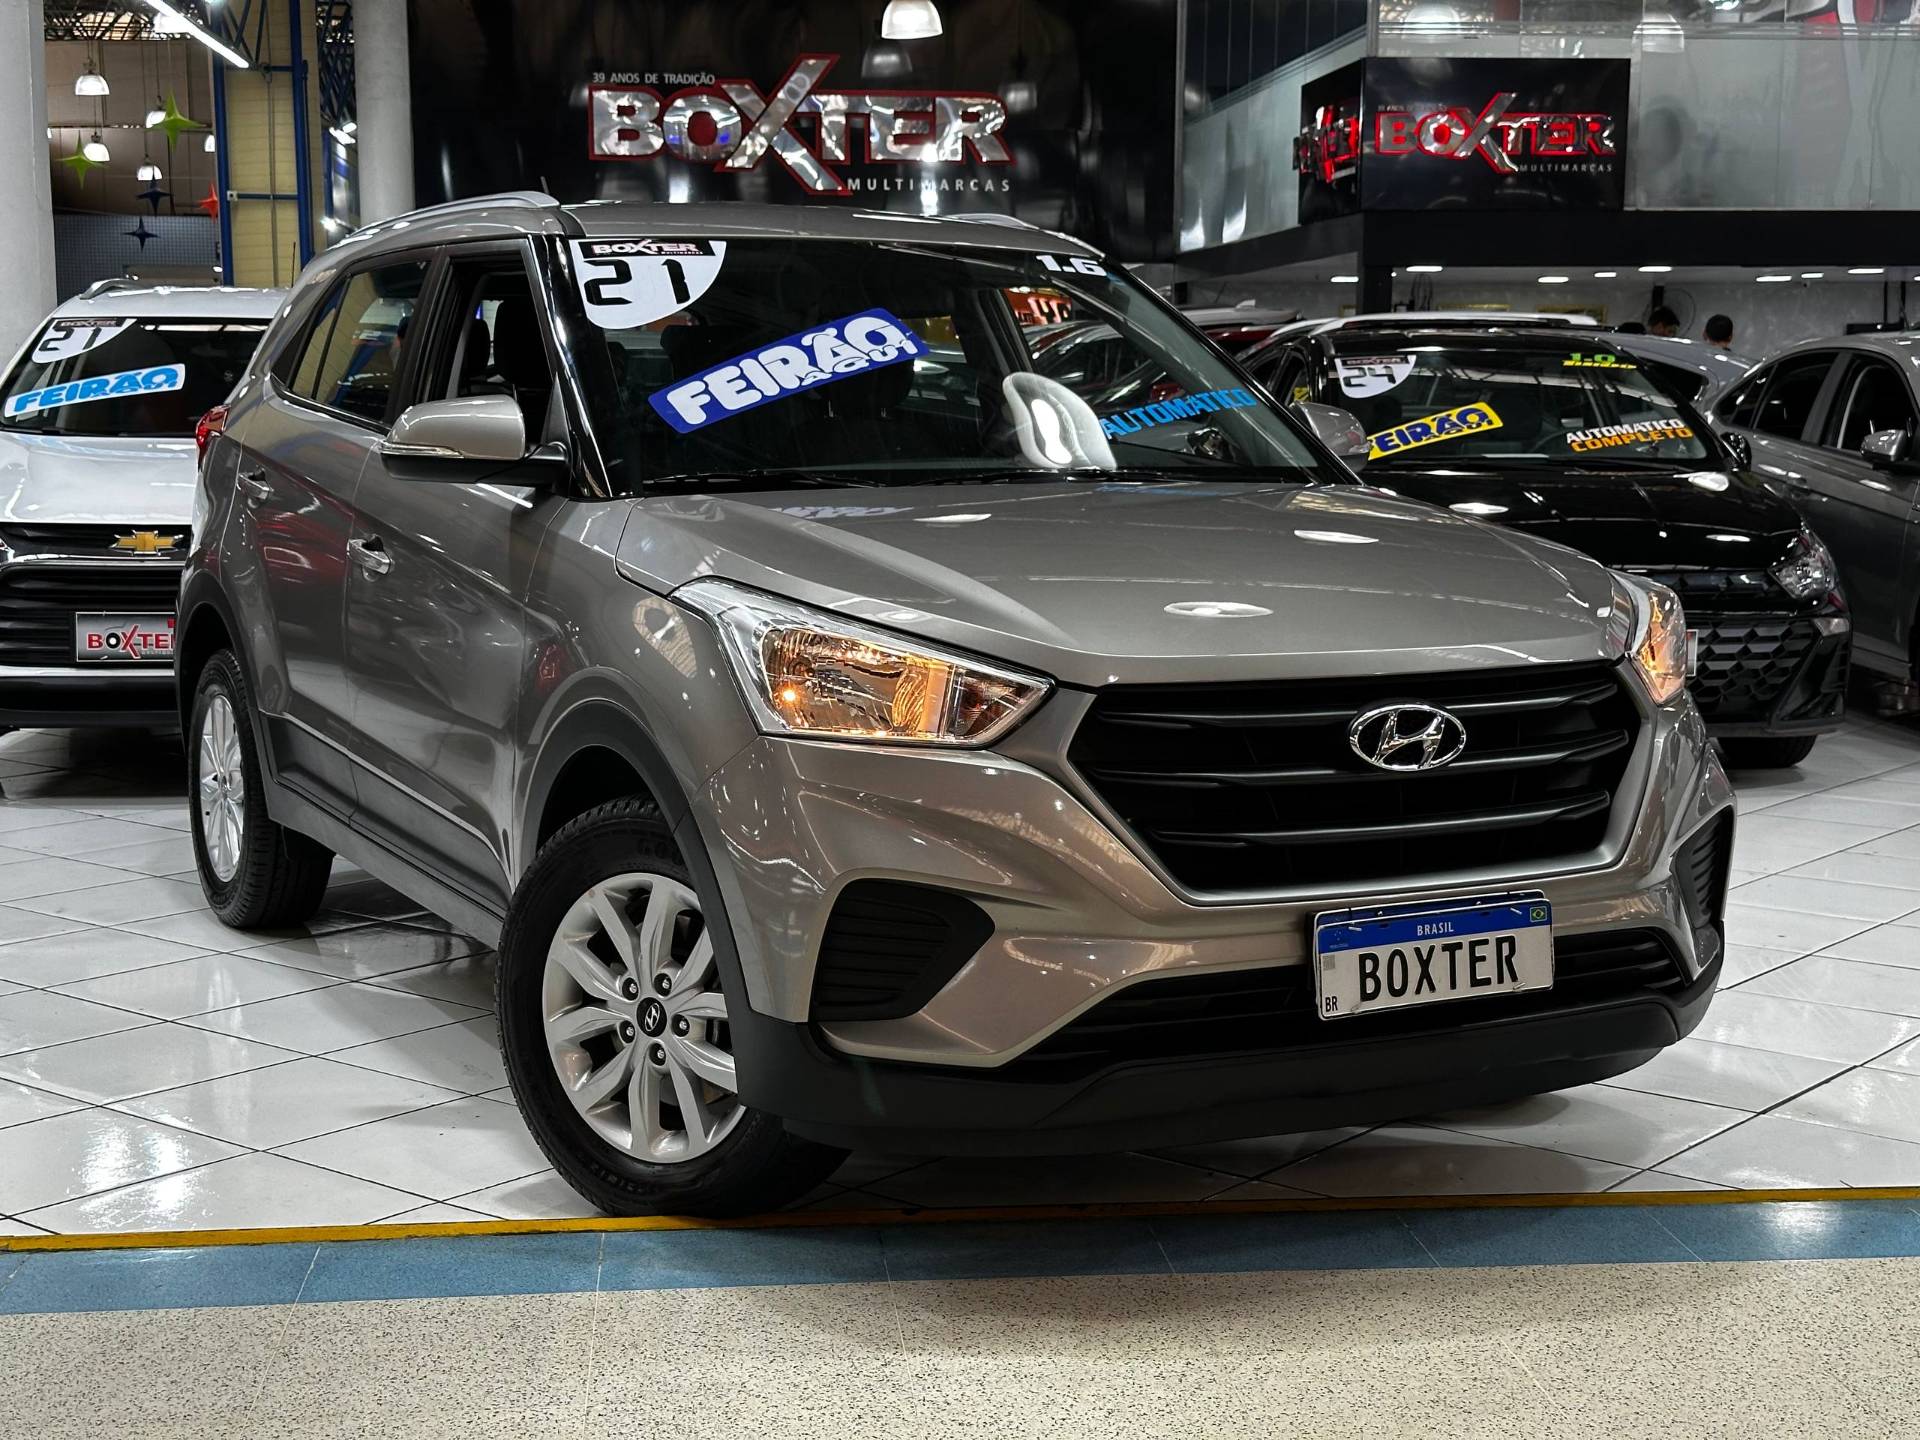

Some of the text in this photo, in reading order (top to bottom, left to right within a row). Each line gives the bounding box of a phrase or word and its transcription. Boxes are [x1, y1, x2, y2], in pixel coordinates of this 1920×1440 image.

[592, 72, 716, 86] 39 ANOS DE TRADIÇÃO
[588, 53, 1016, 195] BOXTER
[1375, 92, 1616, 174] BOXTER
[1519, 163, 1613, 173] MULTIMARCAS
[847, 178, 1010, 192] MULTIMARCAS
[592, 239, 700, 254] BOXTER
[1036, 255, 1107, 276] 1.6
[583, 258, 691, 306] 21
[38, 325, 103, 352] 21
[667, 317, 909, 425] FEIRÃO
[1342, 365, 1397, 388] 24
[14, 367, 179, 412] FEIRÃO
[1369, 407, 1490, 453] EIRÃO
[1566, 418, 1685, 444] AUTOMATICO
[1570, 427, 1693, 453] COMPLETO
[1416, 921, 1455, 936] BRASIL
[1358, 934, 1519, 1003] BOXTER
[1325, 996, 1338, 1012] BR
